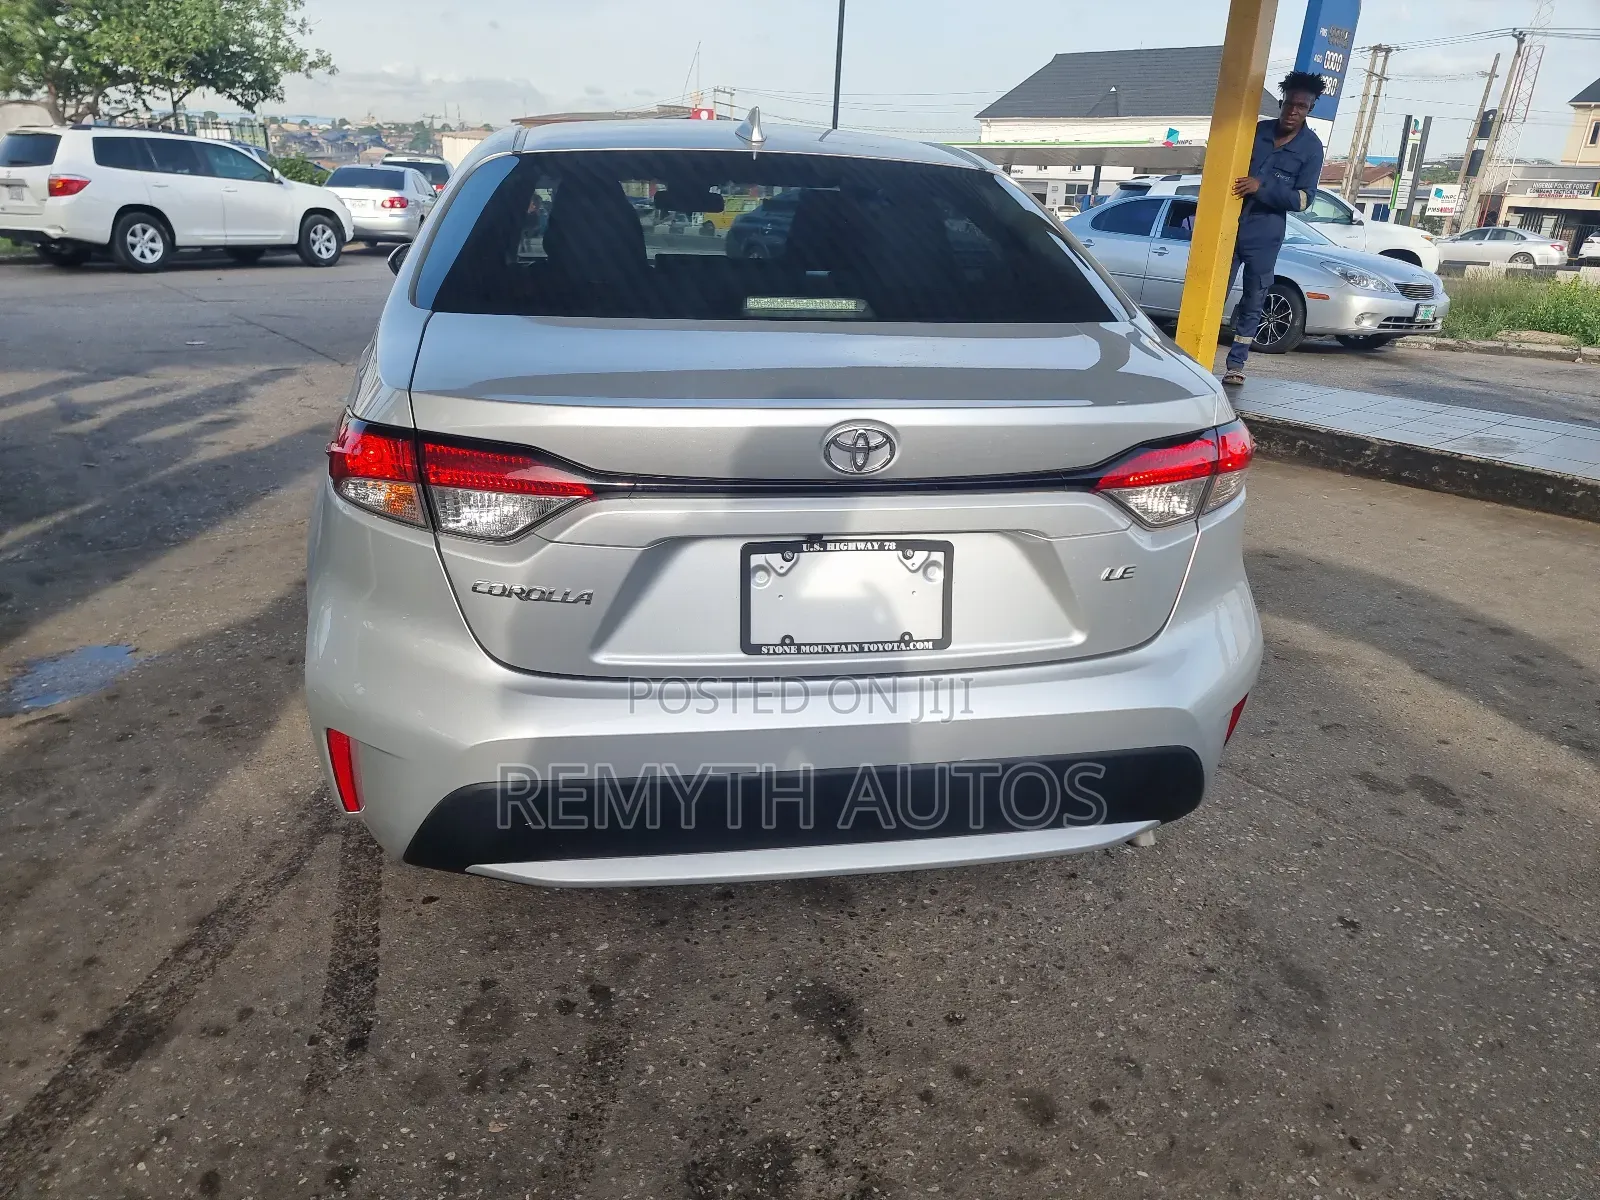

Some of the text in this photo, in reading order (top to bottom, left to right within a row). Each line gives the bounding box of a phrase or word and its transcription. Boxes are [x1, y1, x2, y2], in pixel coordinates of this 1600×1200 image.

[801, 541, 897, 551] U.S. HIGHWAY 78
[1100, 564, 1137, 581] LE
[471, 578, 594, 605] COROLLA
[761, 641, 933, 654] STONE MOUNTAIN TOYOTA.COM
